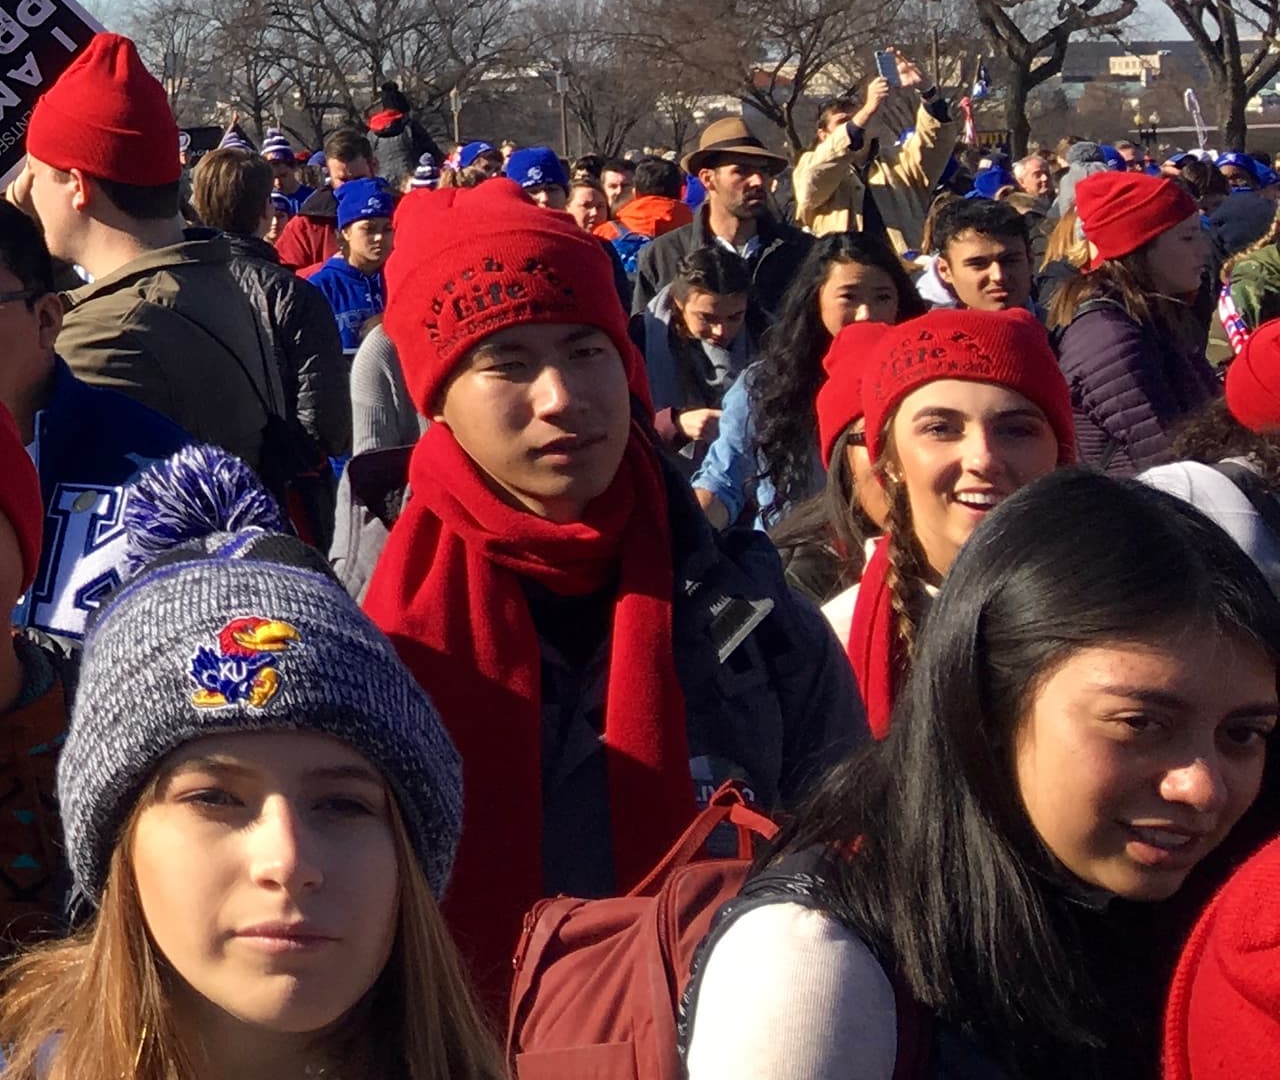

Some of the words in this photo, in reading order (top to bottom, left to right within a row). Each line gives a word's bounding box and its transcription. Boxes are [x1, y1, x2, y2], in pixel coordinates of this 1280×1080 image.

[51, 26, 77, 52] I
[452, 280, 528, 321] Life
[219, 661, 248, 683] KU
